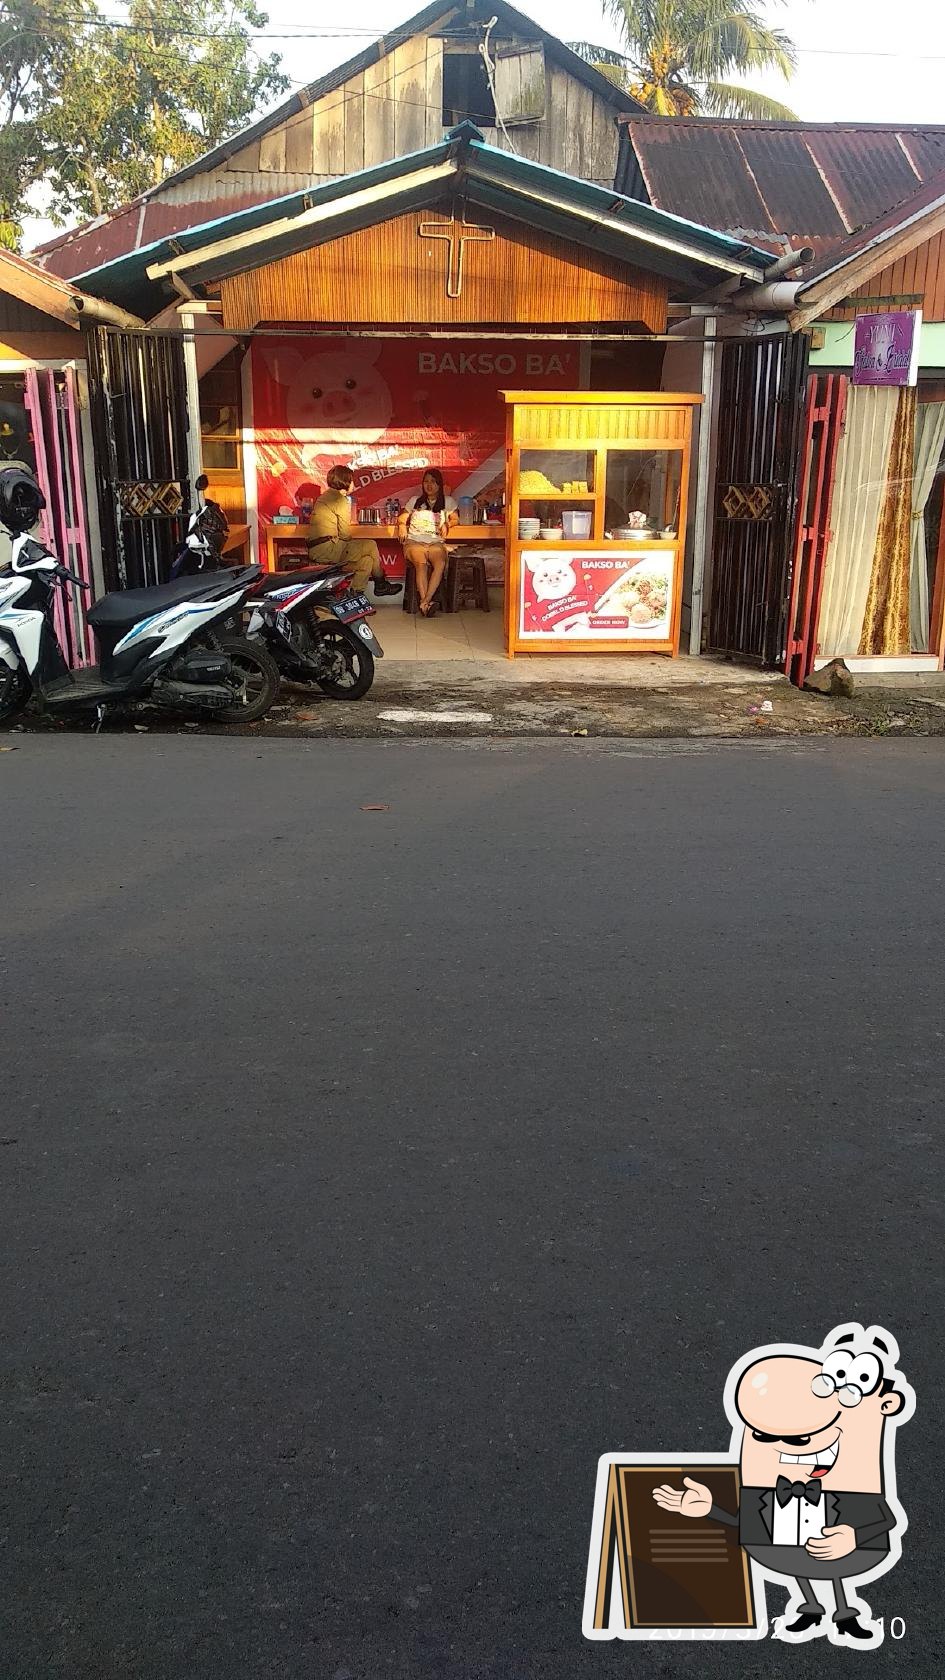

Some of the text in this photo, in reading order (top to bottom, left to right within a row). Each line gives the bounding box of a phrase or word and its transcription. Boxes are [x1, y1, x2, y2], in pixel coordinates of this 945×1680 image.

[418, 352, 571, 375] BAKSO BA'
[581, 560, 614, 569] BAKSO
[547, 598, 568, 611] BAKSO
